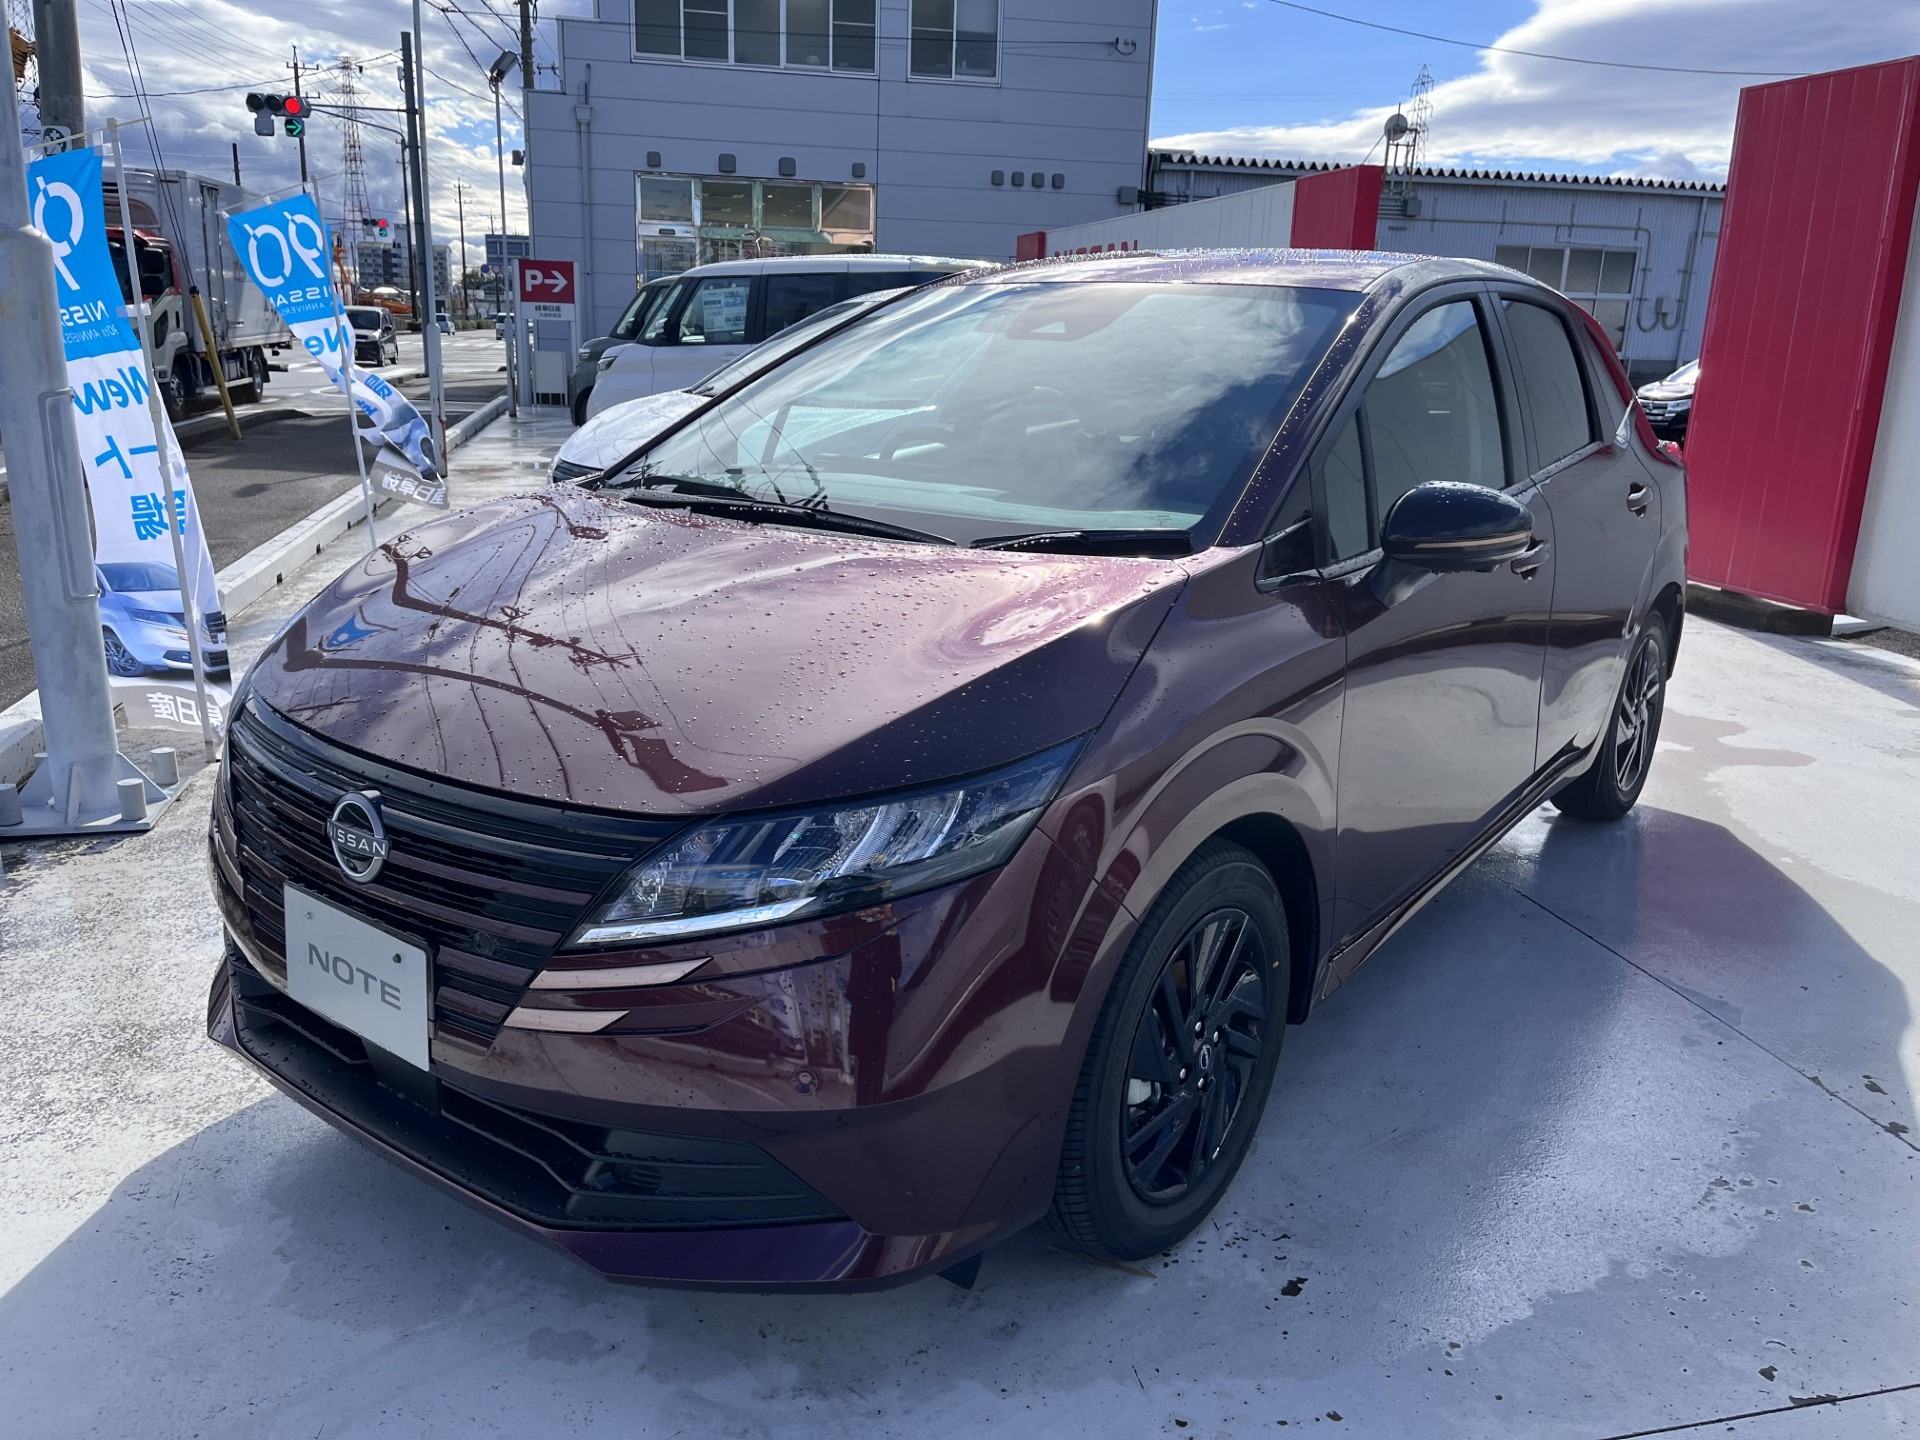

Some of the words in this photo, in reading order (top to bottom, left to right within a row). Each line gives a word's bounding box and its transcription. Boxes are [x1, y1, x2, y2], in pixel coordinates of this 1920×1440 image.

[525, 269, 544, 292] P
[327, 824, 387, 857] NISSAN
[307, 941, 402, 1012] NOTE
